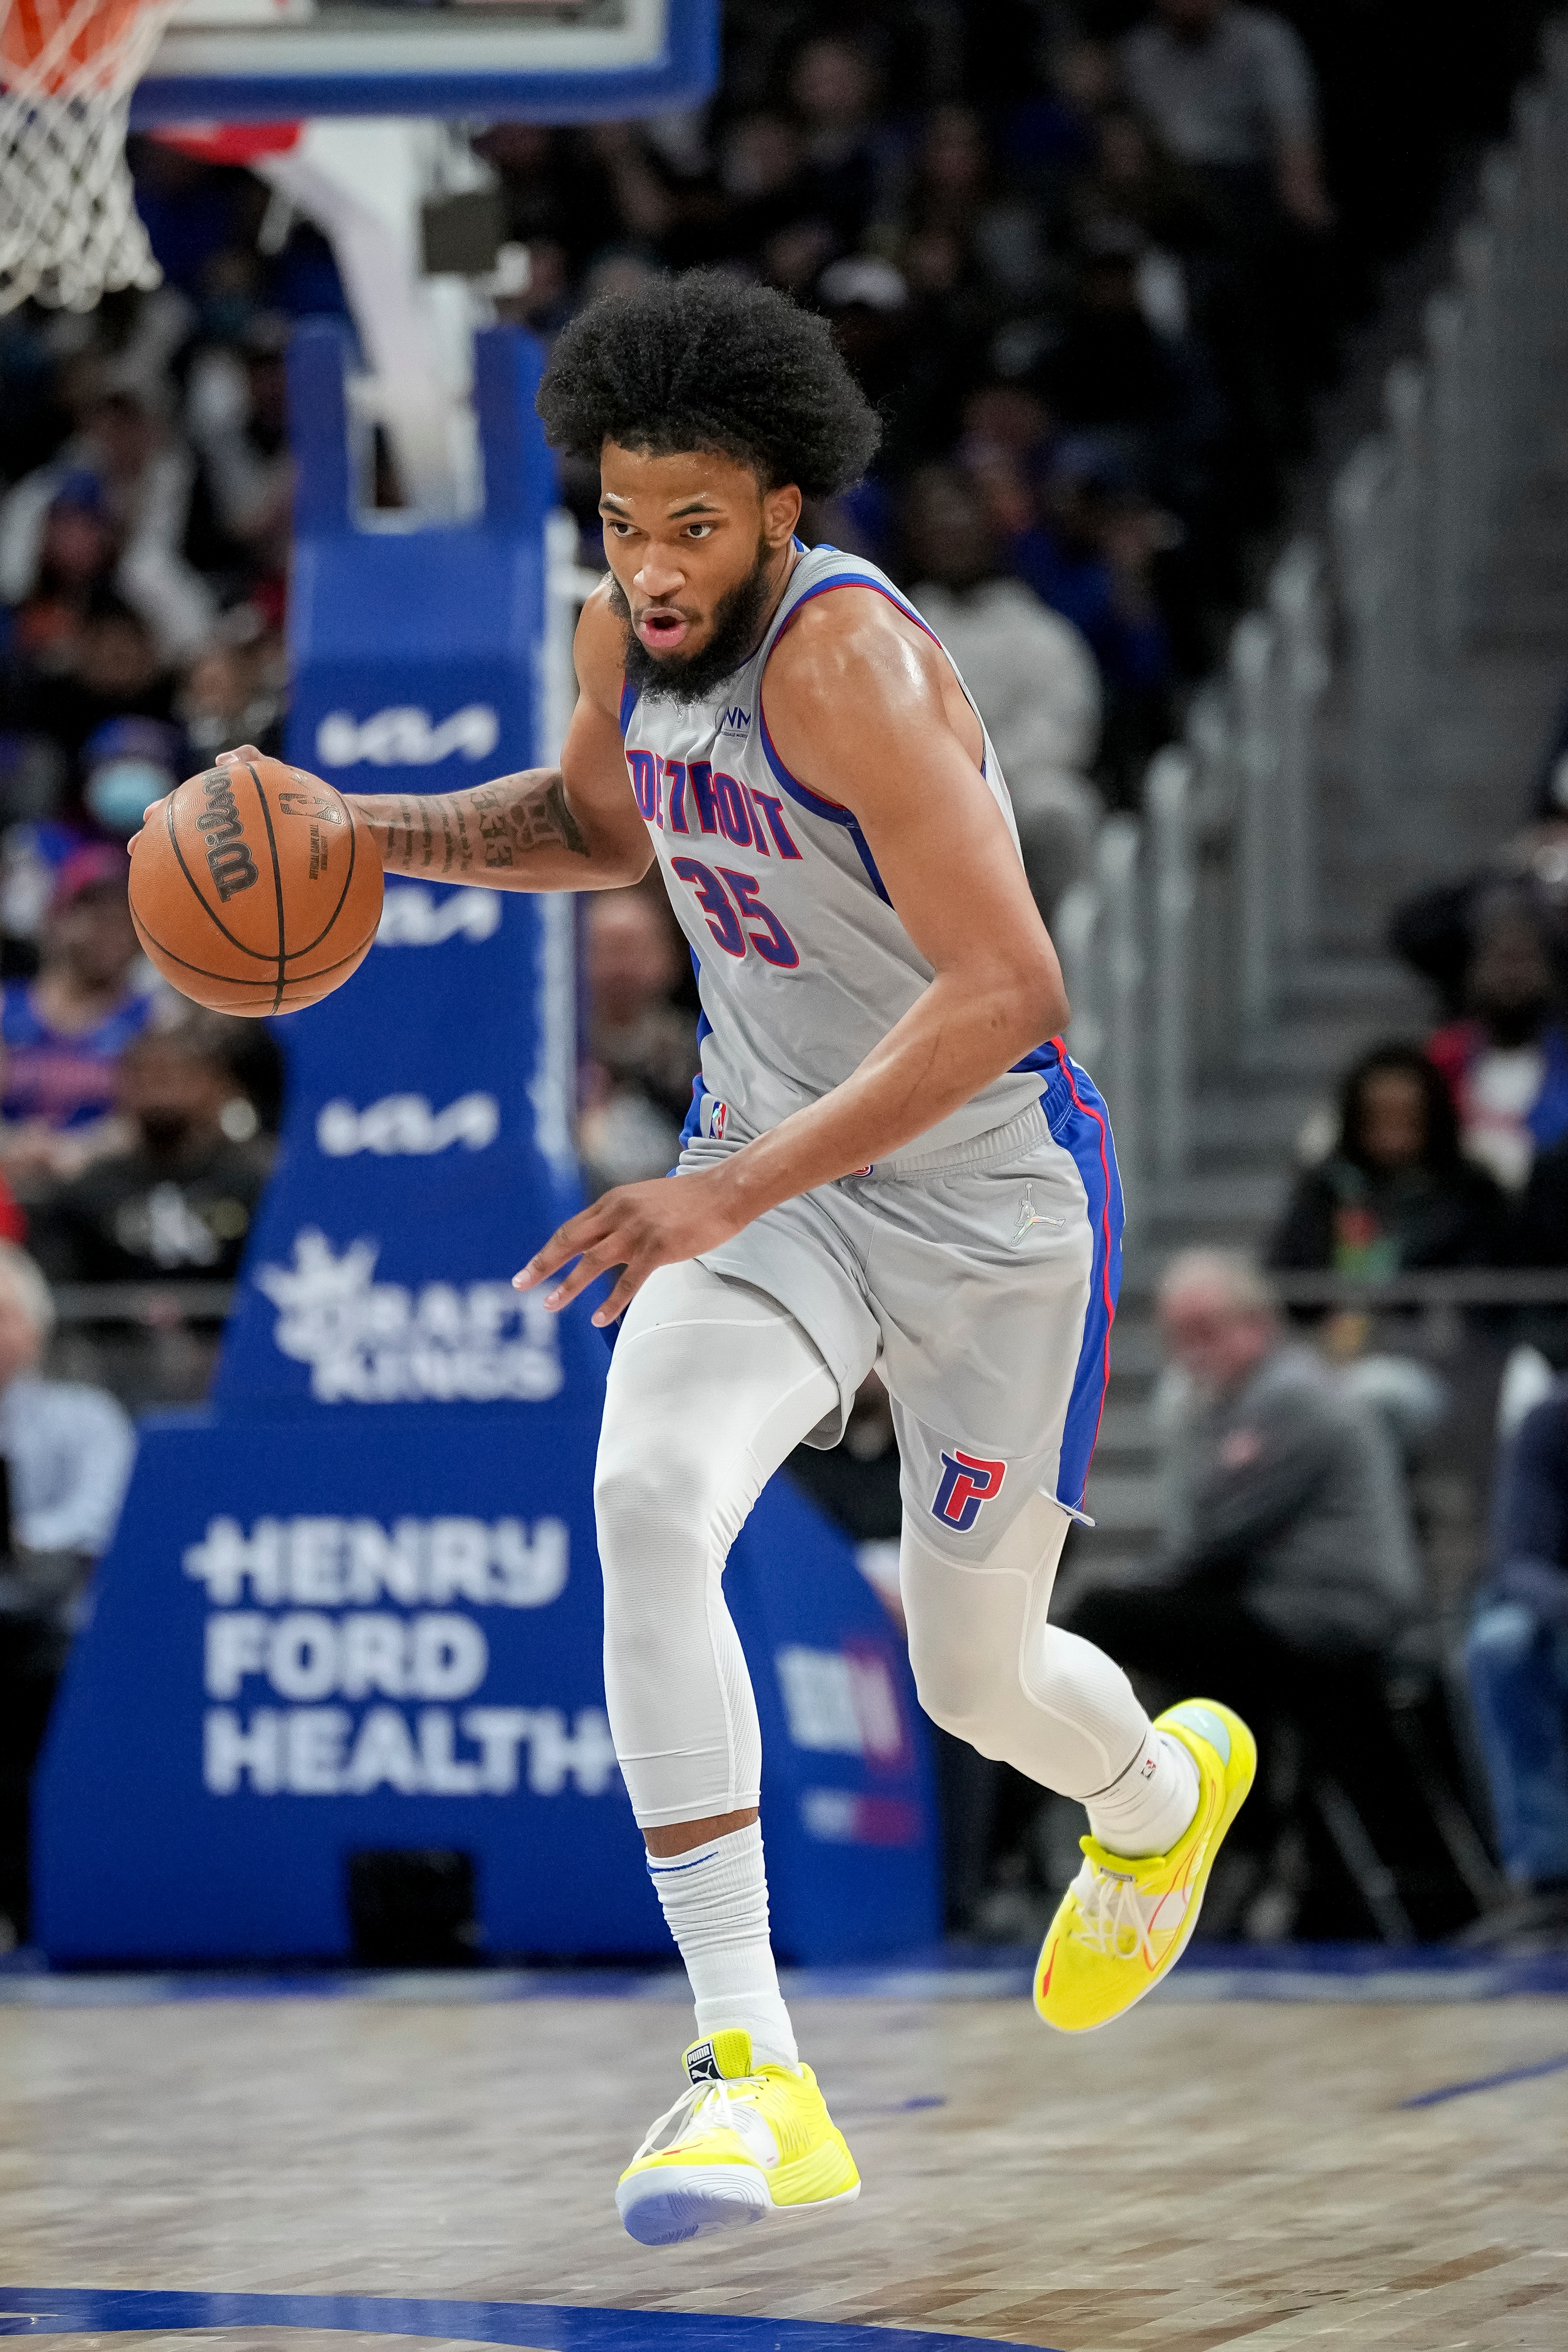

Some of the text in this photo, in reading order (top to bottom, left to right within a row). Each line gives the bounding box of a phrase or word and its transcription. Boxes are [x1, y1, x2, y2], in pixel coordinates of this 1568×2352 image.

[671, 857, 799, 969] 35
[182, 1514, 569, 1609] HENRY
[205, 1611, 488, 1700] FORD
[205, 1705, 618, 1796] HEALTH
[688, 2045, 710, 2065] PUMA
